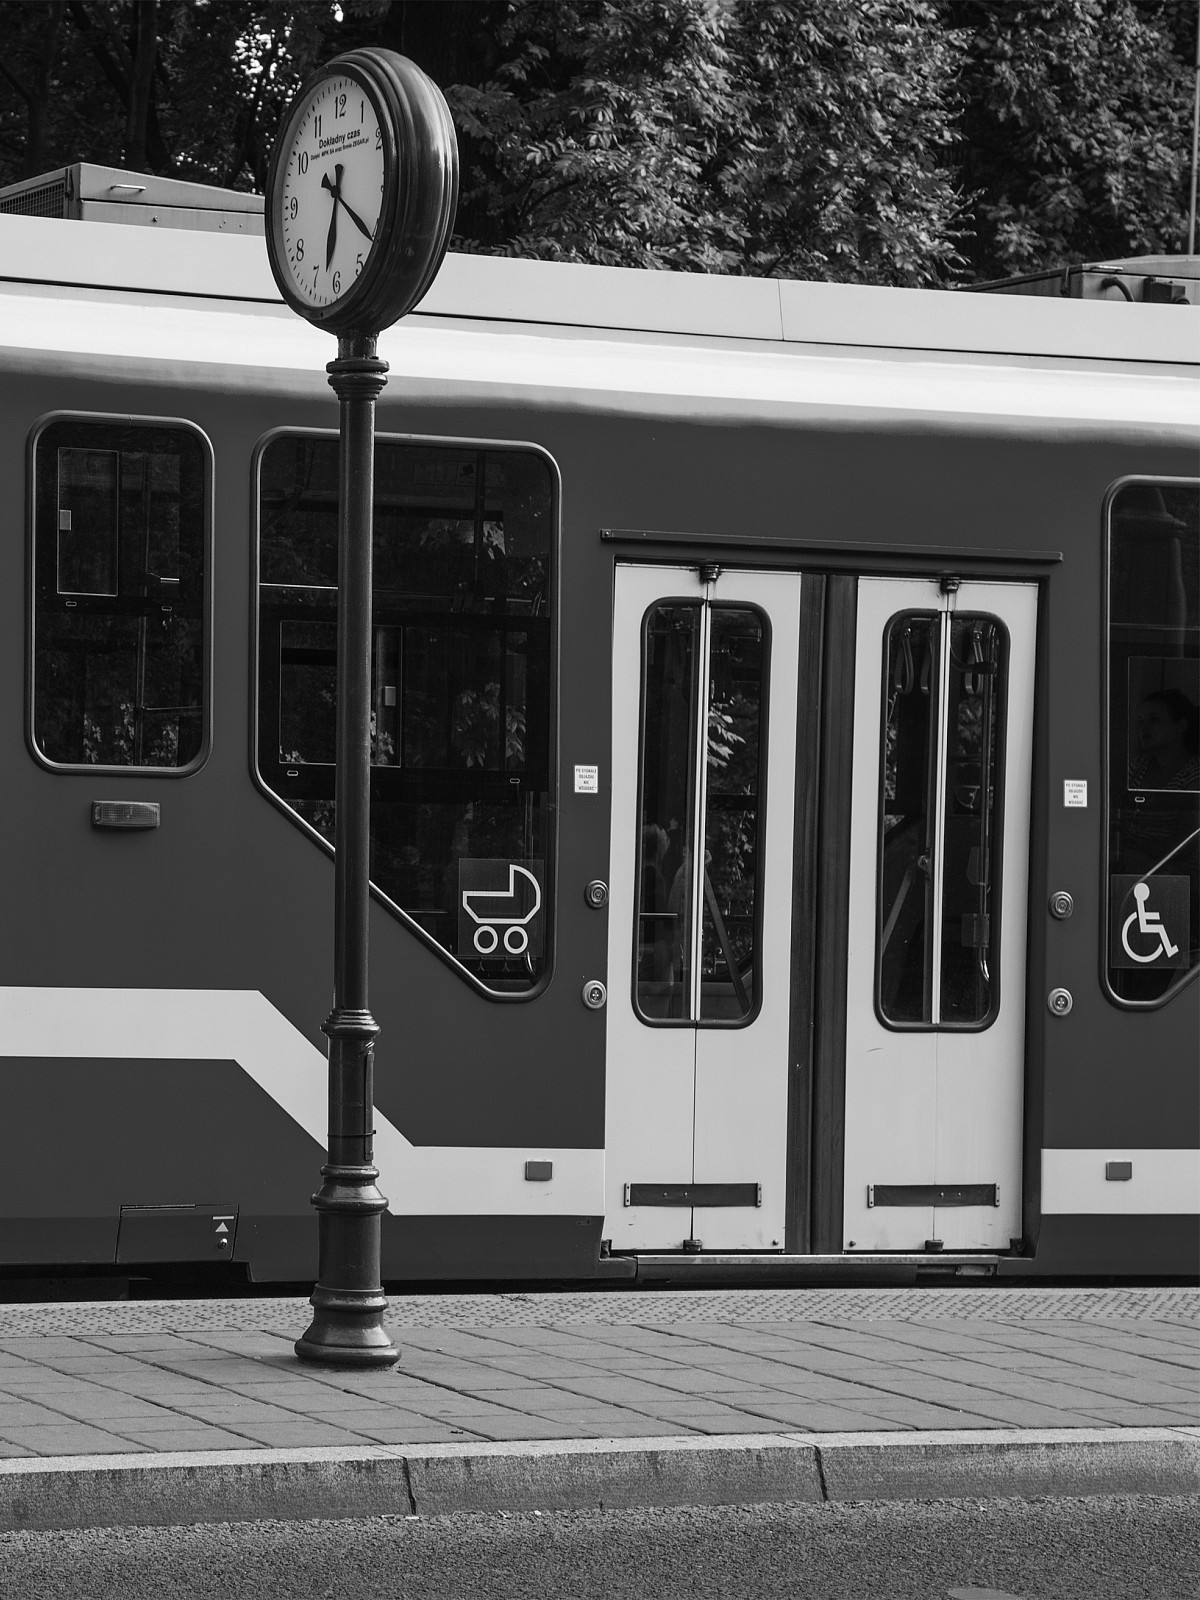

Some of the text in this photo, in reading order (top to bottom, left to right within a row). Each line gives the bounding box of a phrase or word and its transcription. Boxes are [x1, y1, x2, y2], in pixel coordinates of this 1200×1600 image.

[335, 94, 347, 119] 12
[361, 101, 364, 123] 1
[314, 115, 322, 138] 11
[347, 129, 360, 140] czas
[375, 127, 382, 151] 2
[298, 151, 308, 175] 10
[290, 197, 298, 220] 9
[296, 238, 304, 261] 8
[313, 265, 319, 288] 7
[355, 253, 364, 277] 5
[332, 271, 341, 294] 6
